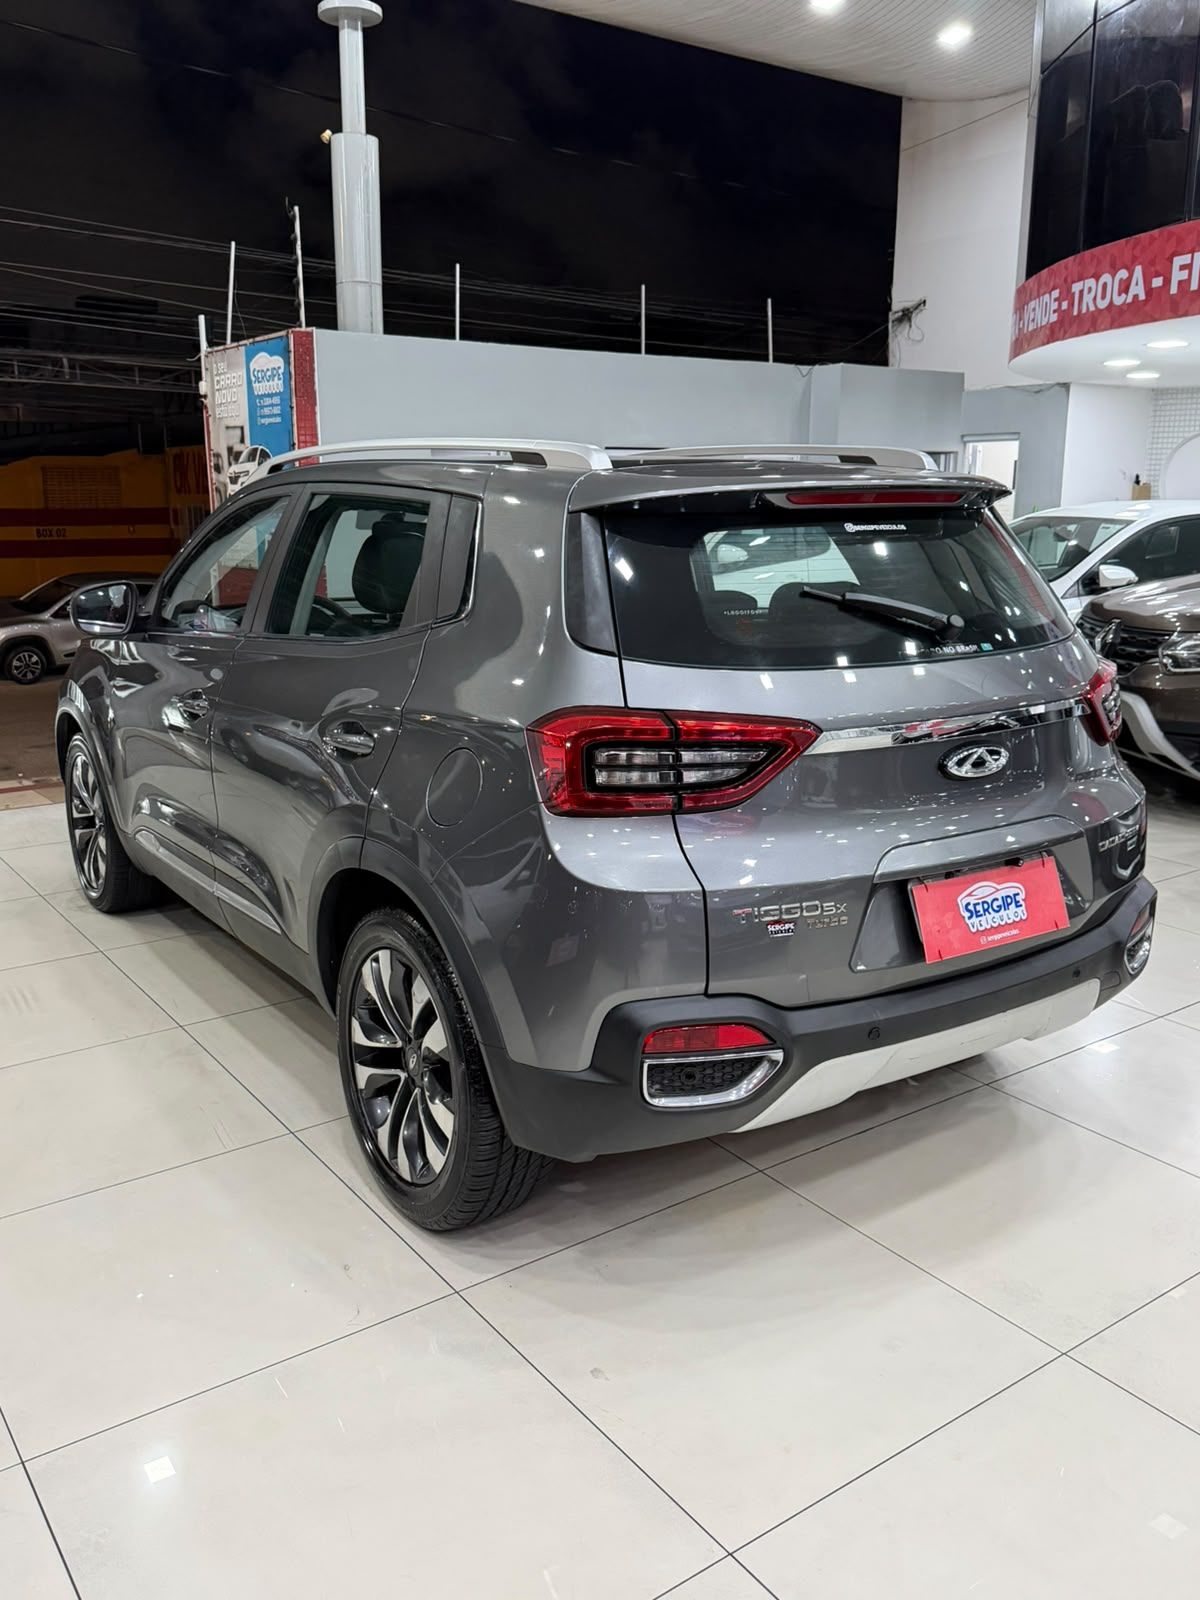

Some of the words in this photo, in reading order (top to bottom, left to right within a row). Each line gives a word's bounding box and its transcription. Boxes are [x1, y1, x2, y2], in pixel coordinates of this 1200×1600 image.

[1024, 288, 1060, 335] VENDE
[1071, 264, 1146, 316] TROCA
[252, 366, 282, 384] SERGIPE
[216, 388, 238, 404] NOVO
[36, 528, 53, 538] BOX
[56, 527, 67, 537] 02
[964, 892, 1023, 920] SERGIPE
